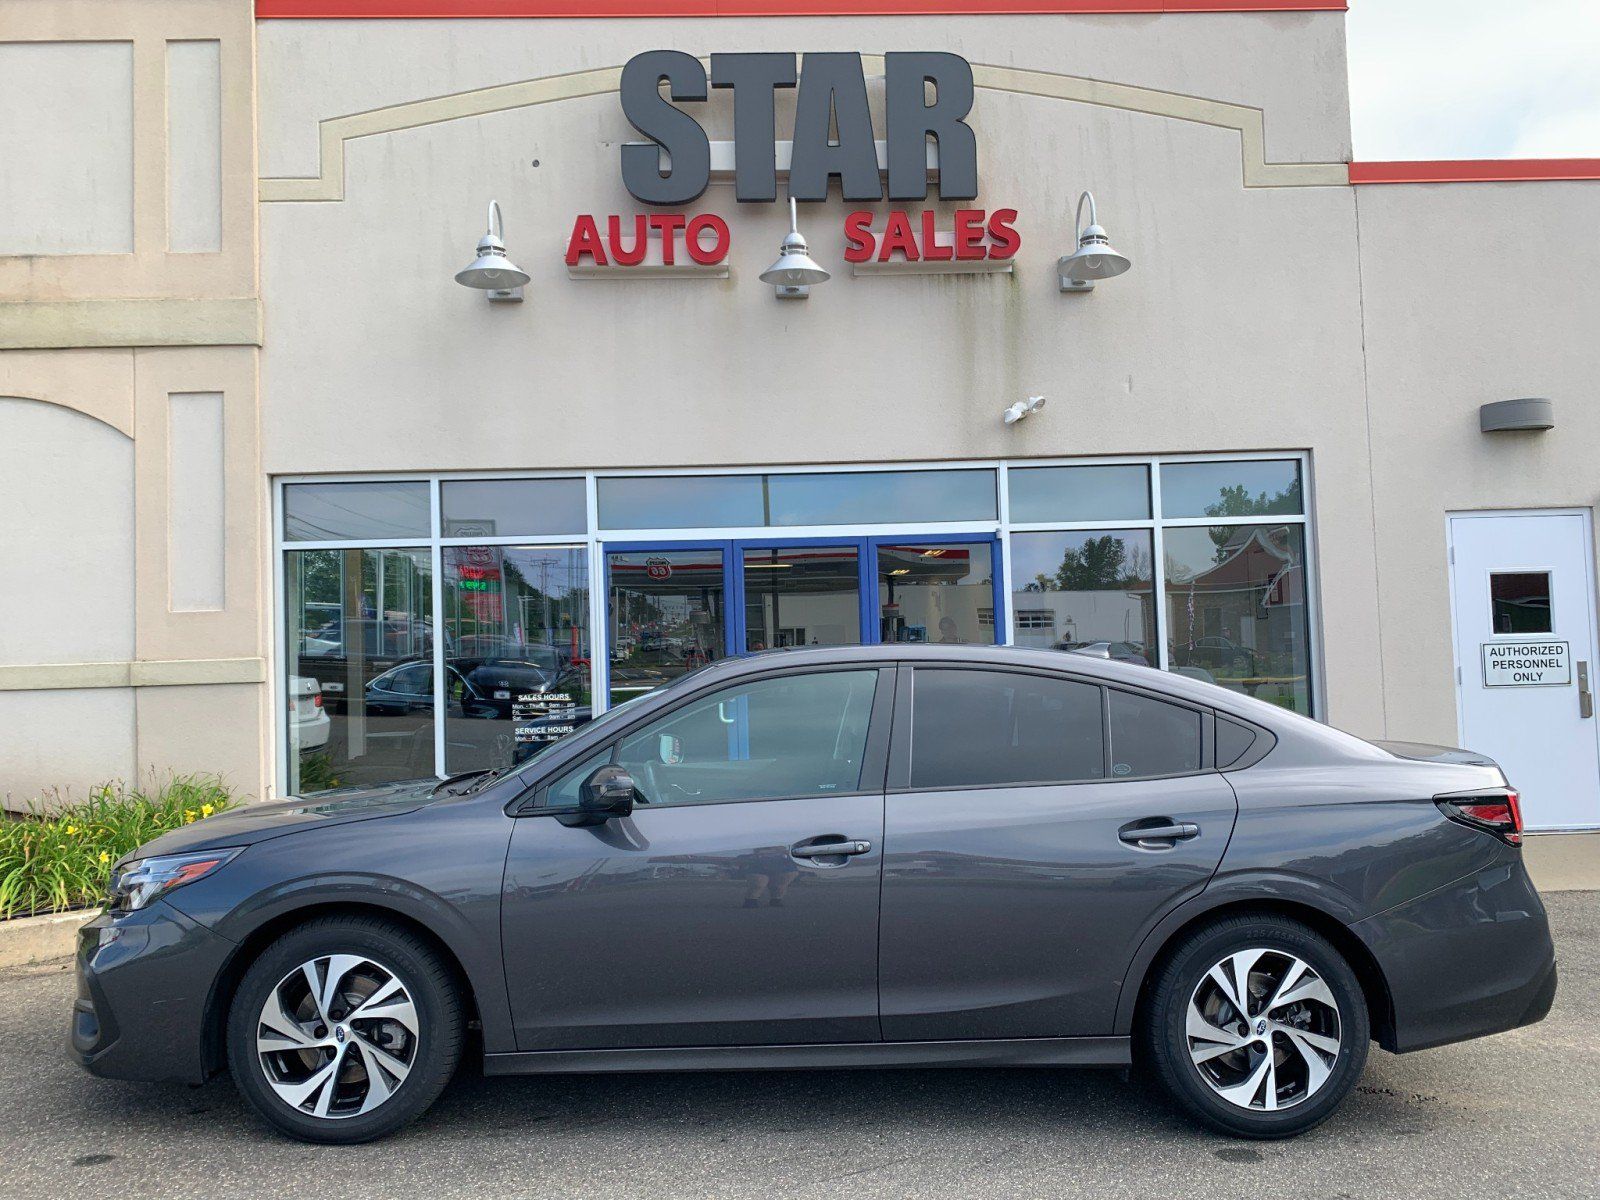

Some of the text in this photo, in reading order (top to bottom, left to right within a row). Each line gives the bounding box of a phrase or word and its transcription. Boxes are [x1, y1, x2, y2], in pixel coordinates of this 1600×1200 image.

[620, 50, 978, 206] STAR
[565, 209, 1021, 267] AUTO SALES
[1490, 645, 1564, 657] AUTHORIZED
[1492, 659, 1563, 669] PERSONNEL
[1513, 672, 1544, 682] ONLY
[543, 693, 570, 701] HOURS
